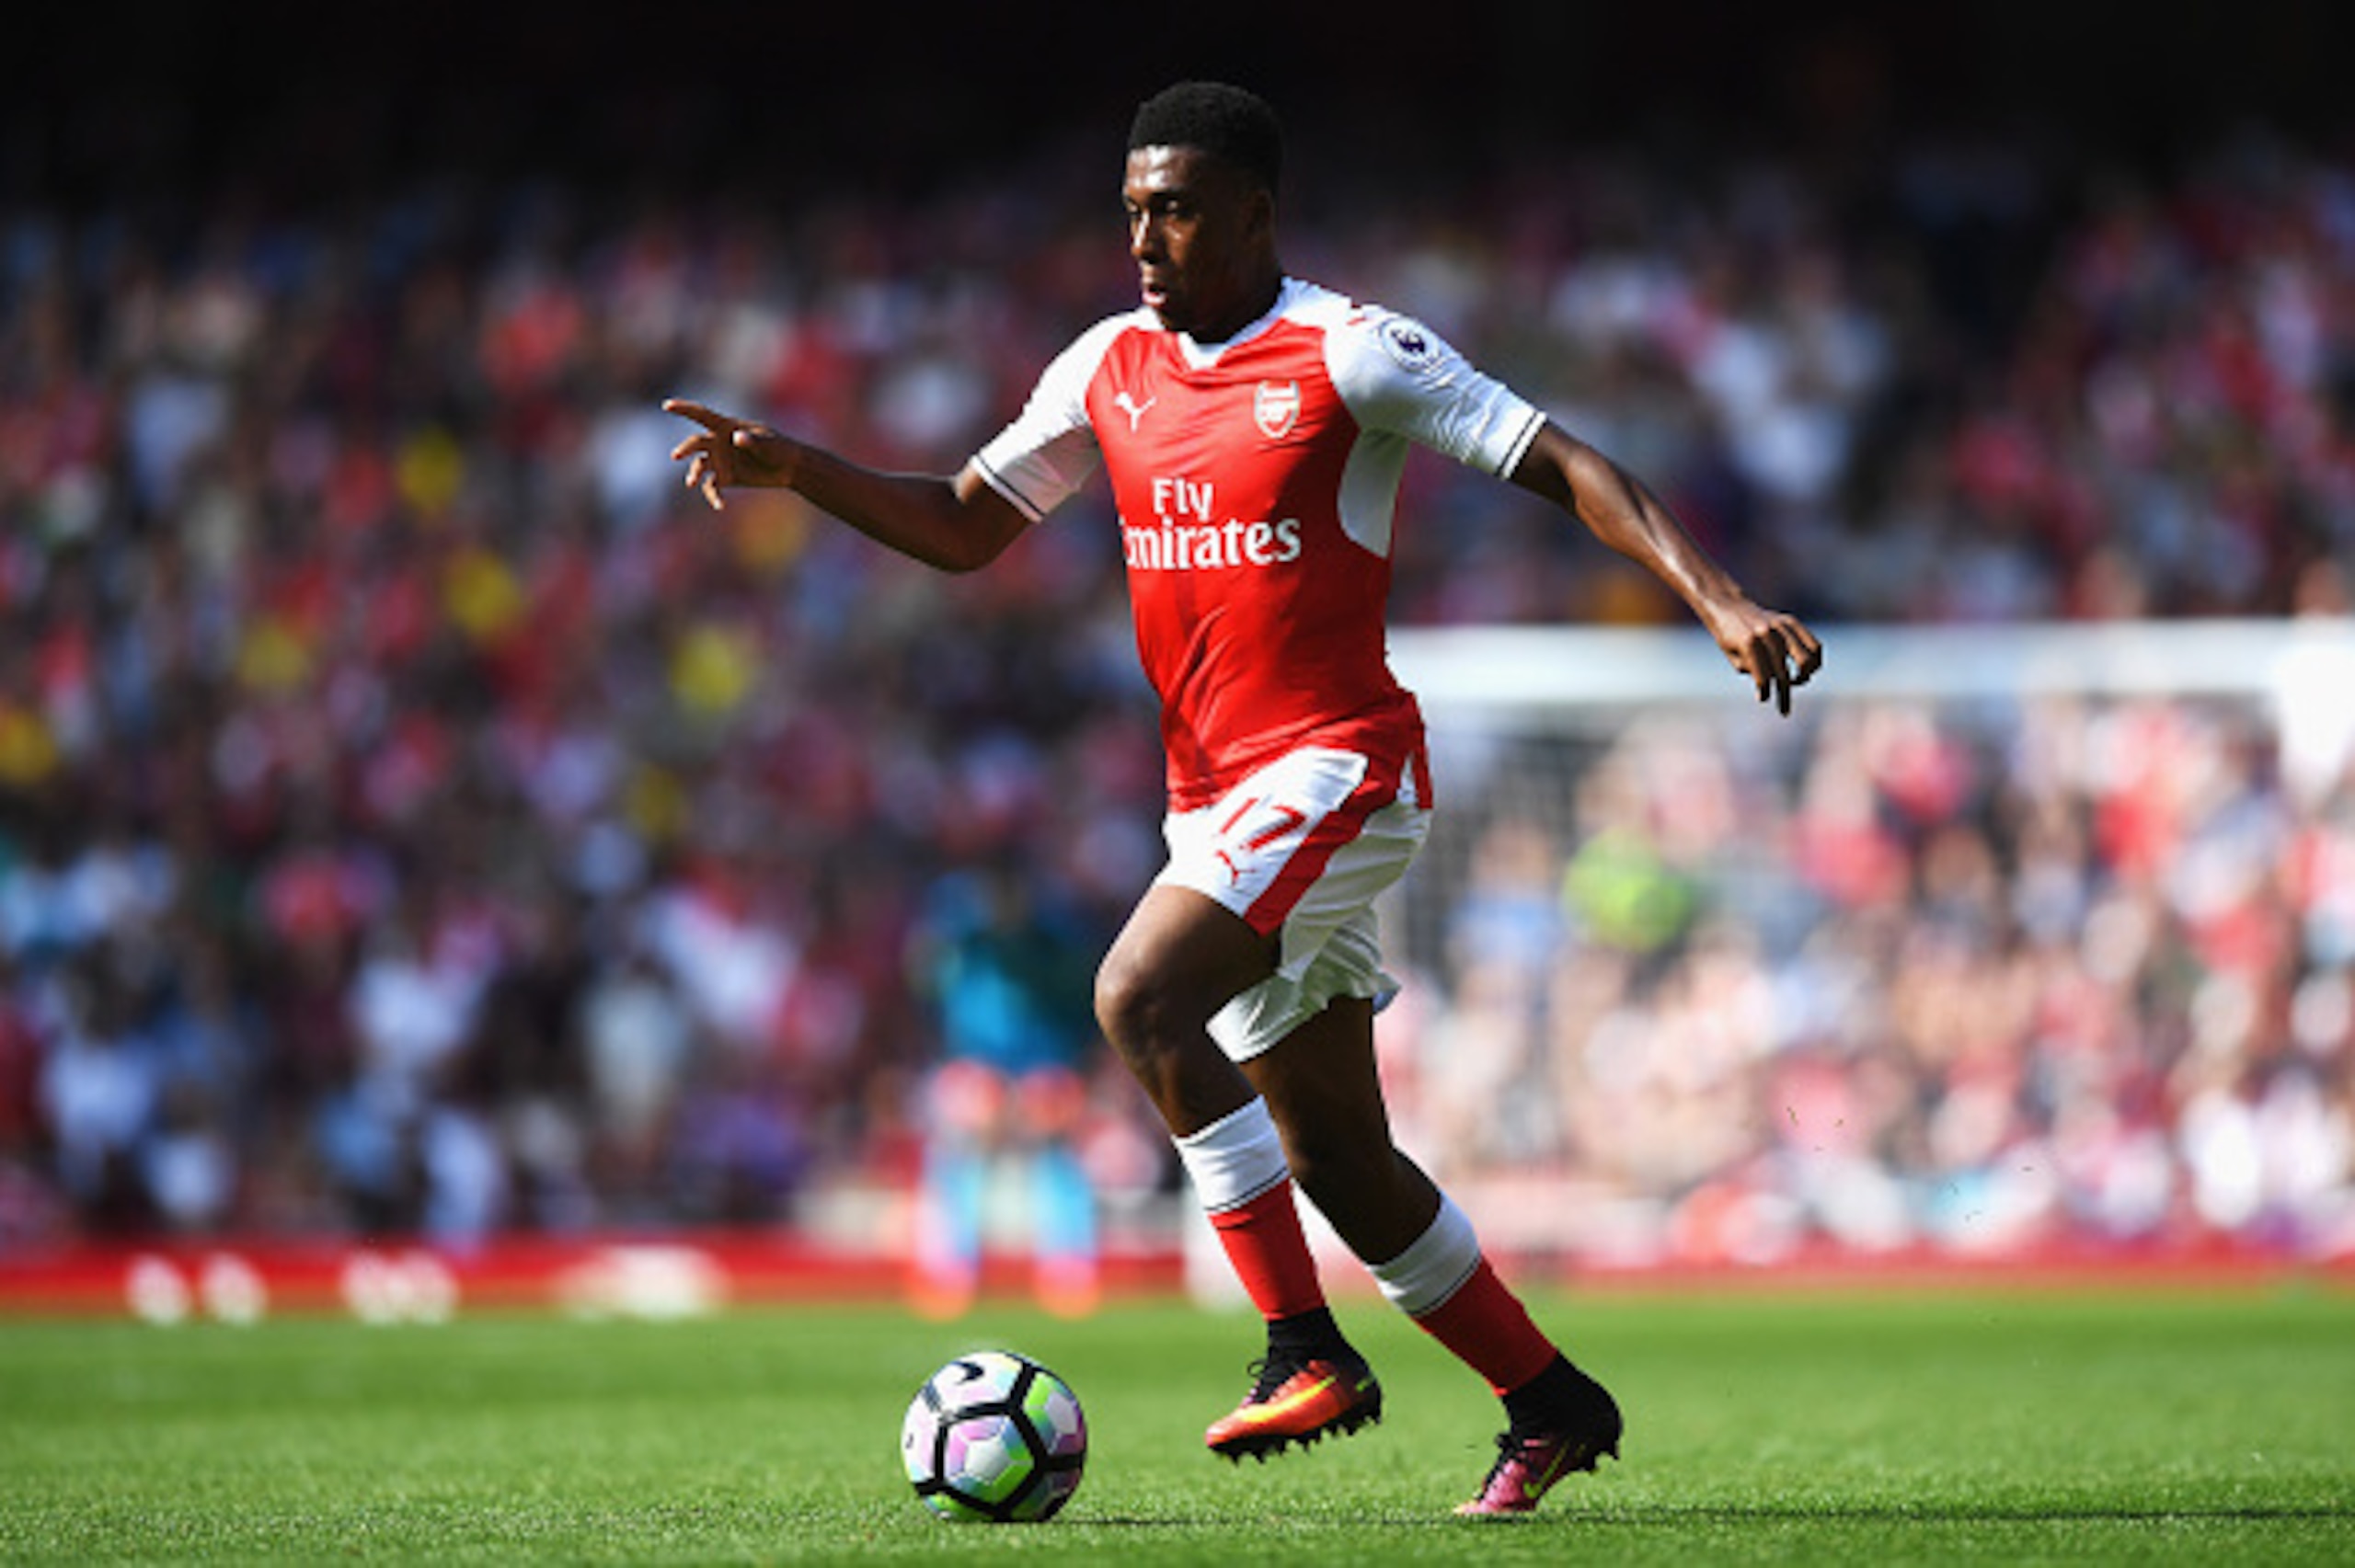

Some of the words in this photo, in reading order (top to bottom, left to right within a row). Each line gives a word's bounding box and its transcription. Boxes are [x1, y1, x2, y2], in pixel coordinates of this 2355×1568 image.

[1152, 476, 1213, 521] Fly
[1119, 515, 1302, 570] mirates
[1219, 796, 1307, 853] 17
